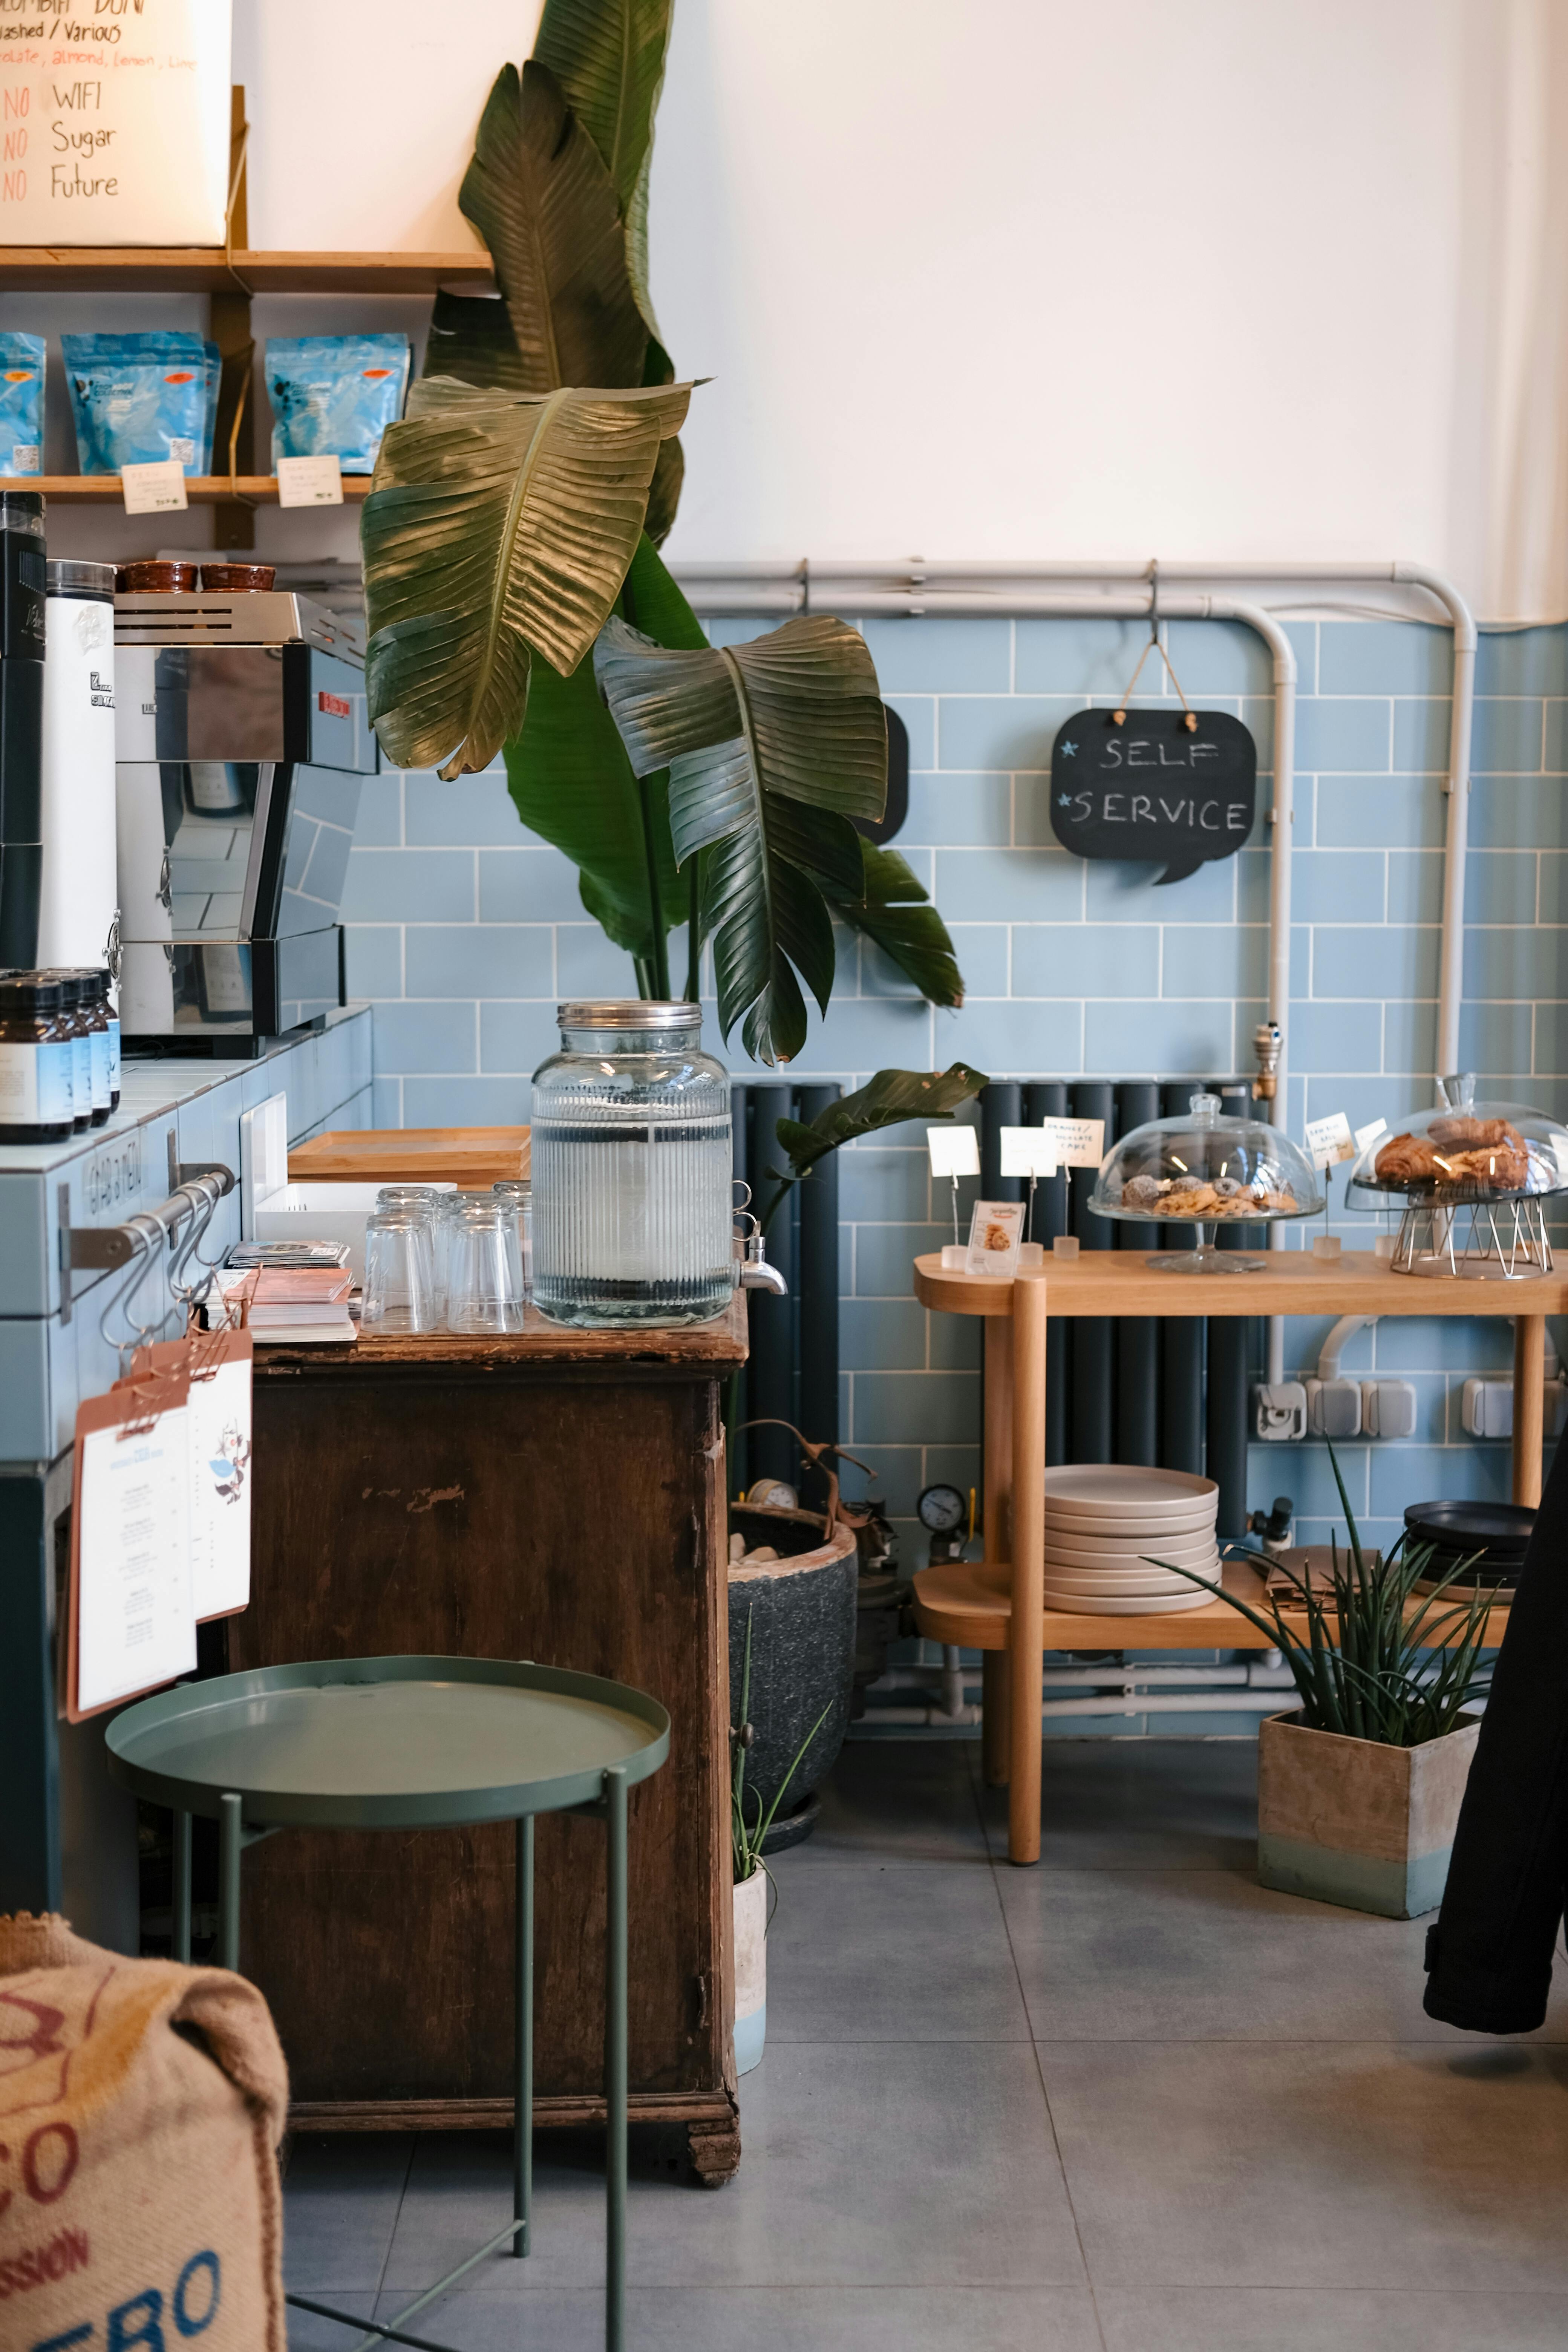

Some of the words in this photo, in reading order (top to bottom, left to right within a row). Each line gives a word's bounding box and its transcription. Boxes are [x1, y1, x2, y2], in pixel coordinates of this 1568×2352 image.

[0, 21, 44, 40] ashed
[64, 20, 122, 44] Various
[0, 48, 46, 67] olate,
[4, 87, 30, 121] NO
[52, 81, 101, 110] WIFI
[3, 128, 28, 162] NO
[52, 121, 117, 159] Sugar
[3, 168, 27, 202] NO
[51, 162, 119, 198] Future
[1099, 739, 1219, 769] SELF
[1070, 791, 1247, 830] SERVICE
[0, 2122, 79, 2216] O
